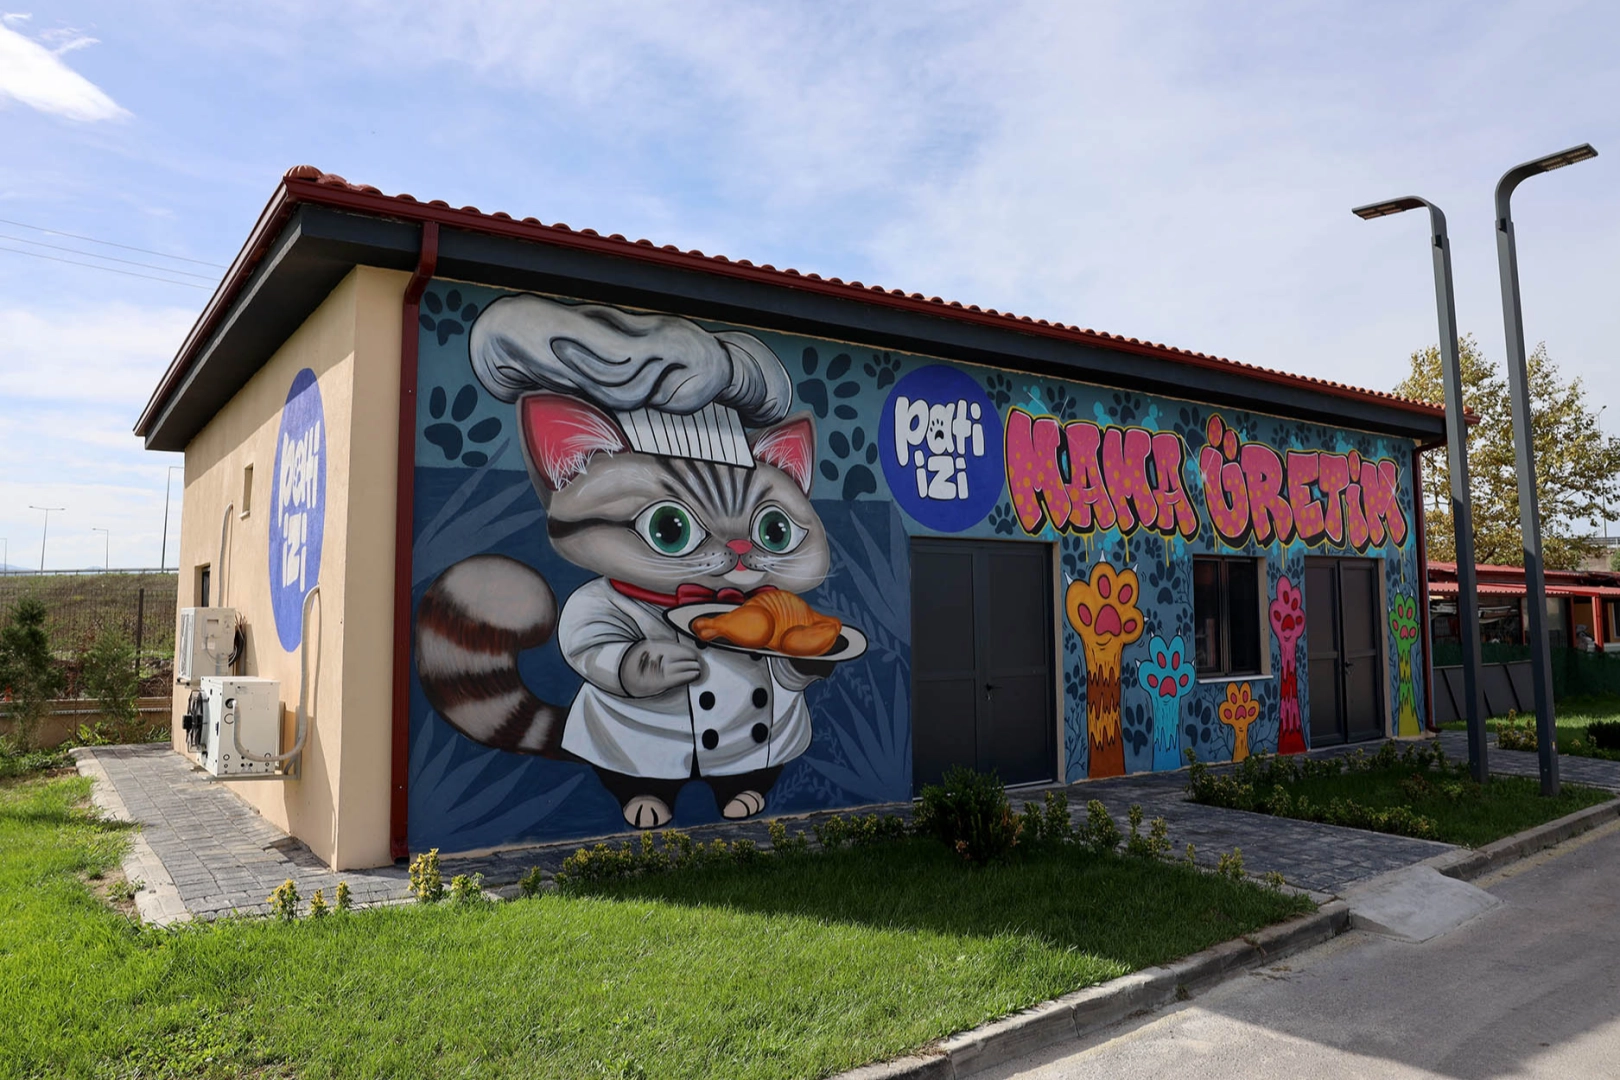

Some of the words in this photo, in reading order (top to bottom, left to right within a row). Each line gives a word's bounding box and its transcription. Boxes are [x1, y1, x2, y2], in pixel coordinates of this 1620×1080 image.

[894, 395, 985, 467] pati
[278, 420, 320, 528] pati
[914, 449, 969, 500] izi
[1004, 406, 1199, 541] MAMA
[282, 511, 307, 593] izi
